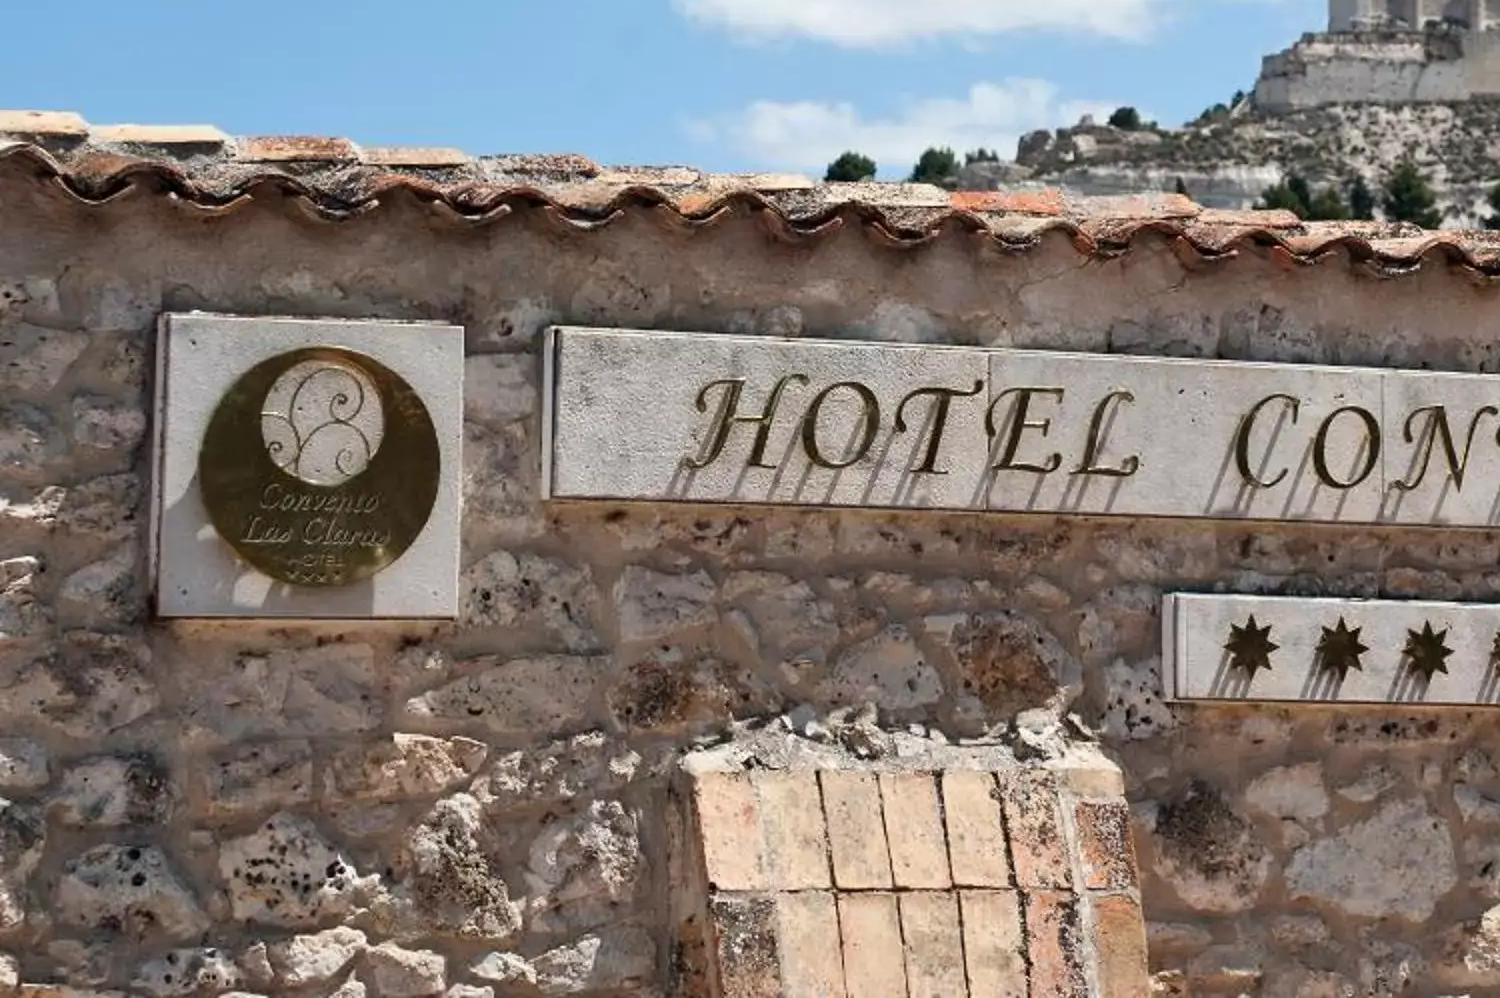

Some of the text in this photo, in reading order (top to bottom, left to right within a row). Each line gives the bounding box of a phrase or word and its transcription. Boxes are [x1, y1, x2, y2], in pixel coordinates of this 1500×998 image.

[682, 373, 1139, 477] HOTEL
[260, 484, 379, 513] Convento
[241, 515, 391, 547] Las Claras
